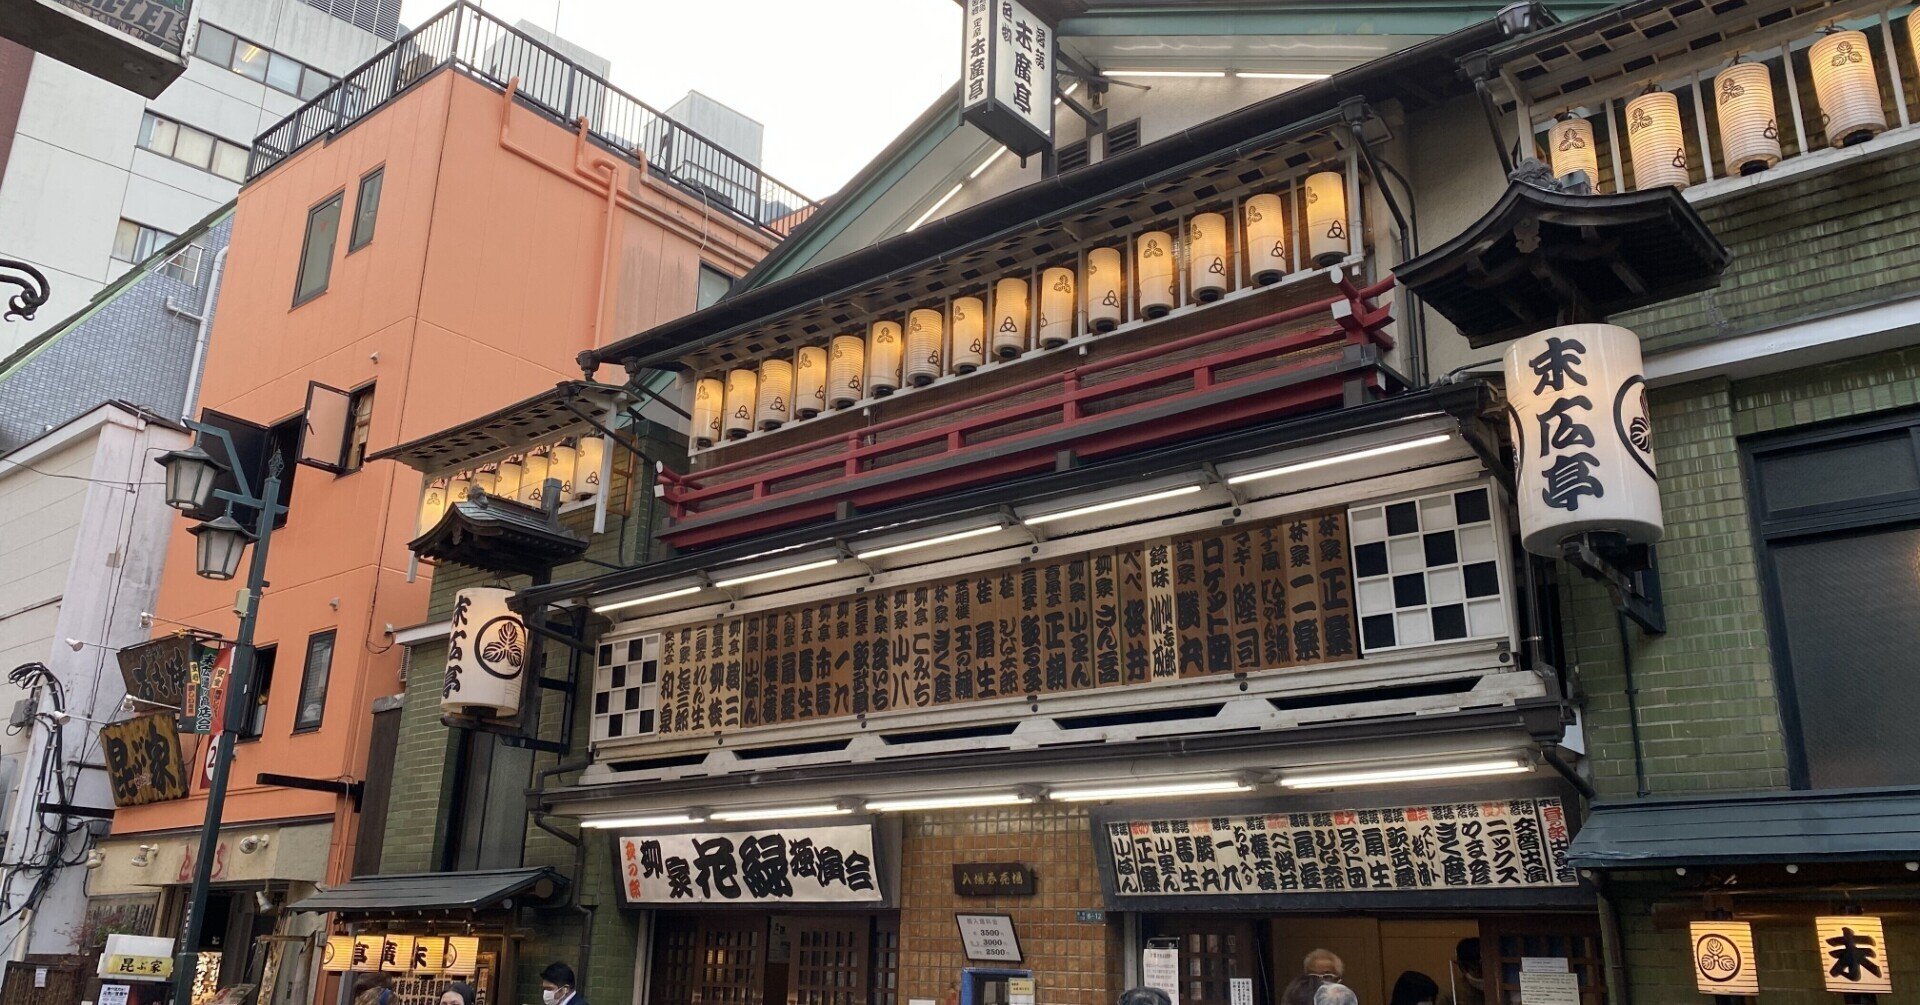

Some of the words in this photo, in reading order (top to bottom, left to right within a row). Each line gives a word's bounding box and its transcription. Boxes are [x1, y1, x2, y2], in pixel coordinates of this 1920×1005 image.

[1529, 337, 1604, 511] 末広亭
[443, 595, 472, 699] 末広亭
[179, 842, 226, 881] とち
[1174, 836, 1201, 892] 馬生
[1216, 840, 1242, 891] 一九
[1487, 819, 1520, 883] ニックス
[120, 958, 163, 974] 昆ぶ家
[1825, 926, 1883, 982] 末
